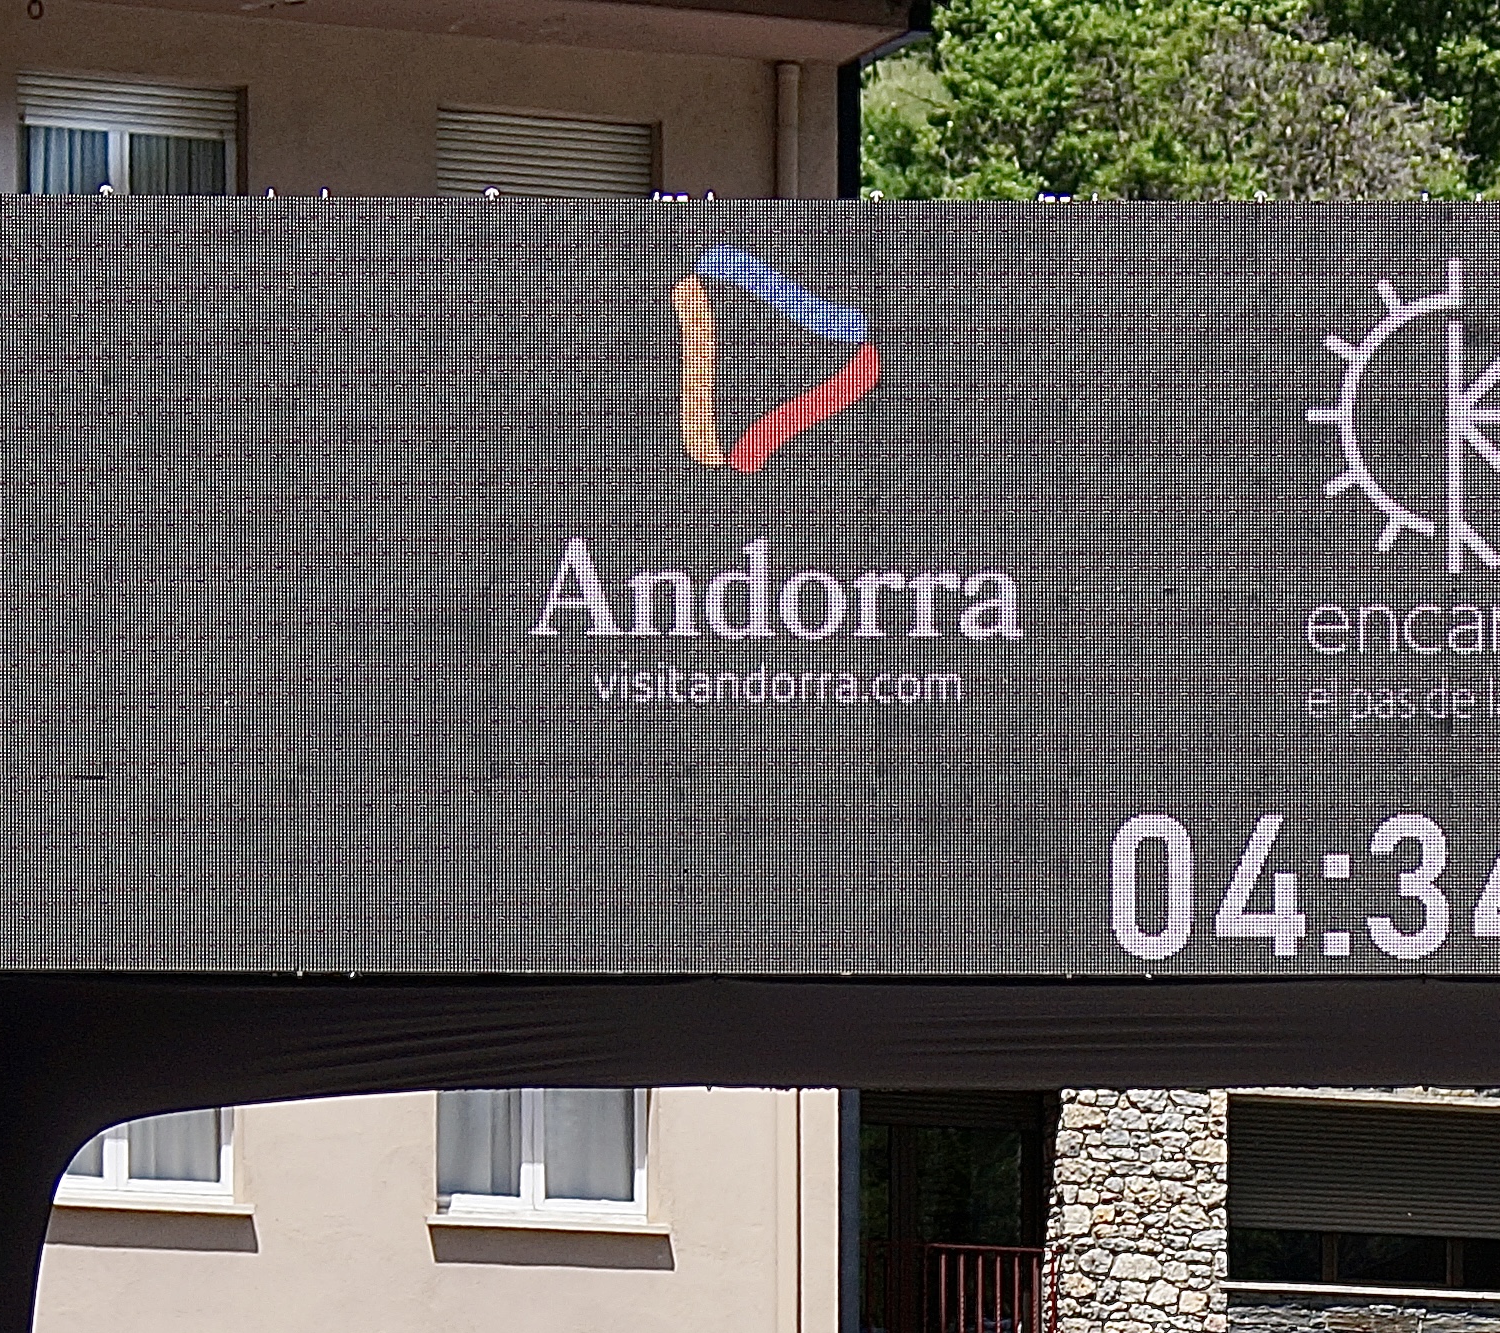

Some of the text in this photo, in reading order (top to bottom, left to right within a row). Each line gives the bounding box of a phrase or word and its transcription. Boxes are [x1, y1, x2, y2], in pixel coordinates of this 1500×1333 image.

[529, 537, 1023, 640] Andorra
[593, 665, 966, 703] visitandorra.com
[1351, 688, 1416, 726] pas
[1428, 678, 1474, 718] de
